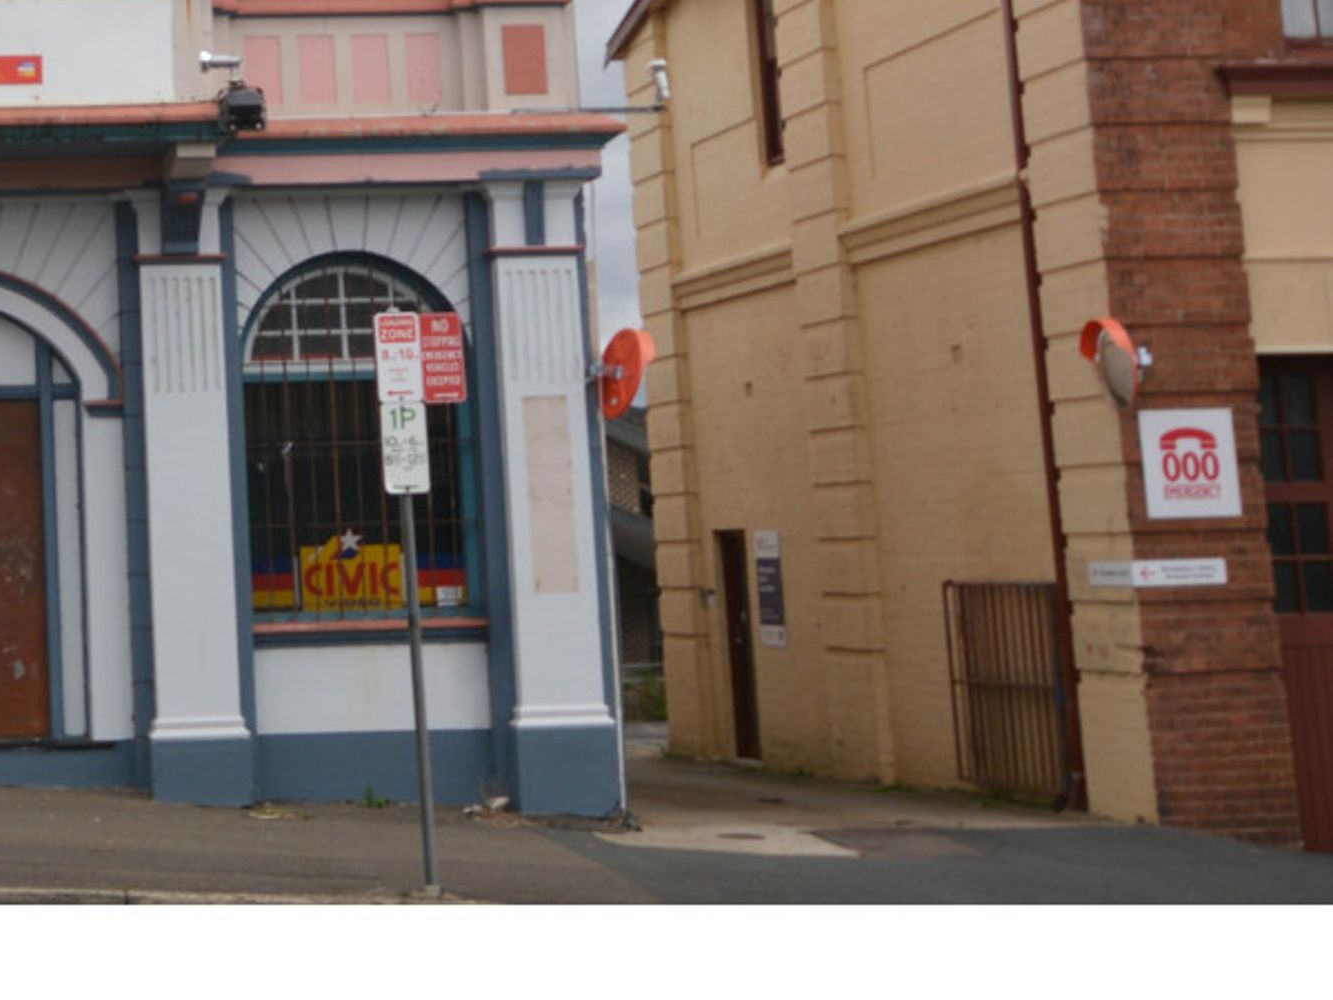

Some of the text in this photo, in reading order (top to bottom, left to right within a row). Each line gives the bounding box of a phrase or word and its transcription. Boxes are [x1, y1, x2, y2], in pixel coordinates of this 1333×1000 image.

[430, 319, 449, 333] NO
[390, 406, 416, 429] 1P
[1163, 451, 1220, 482] 000
[1164, 484, 1222, 499] EMERGENCY
[304, 562, 401, 596] CIVIC
[325, 598, 380, 607] VDO
